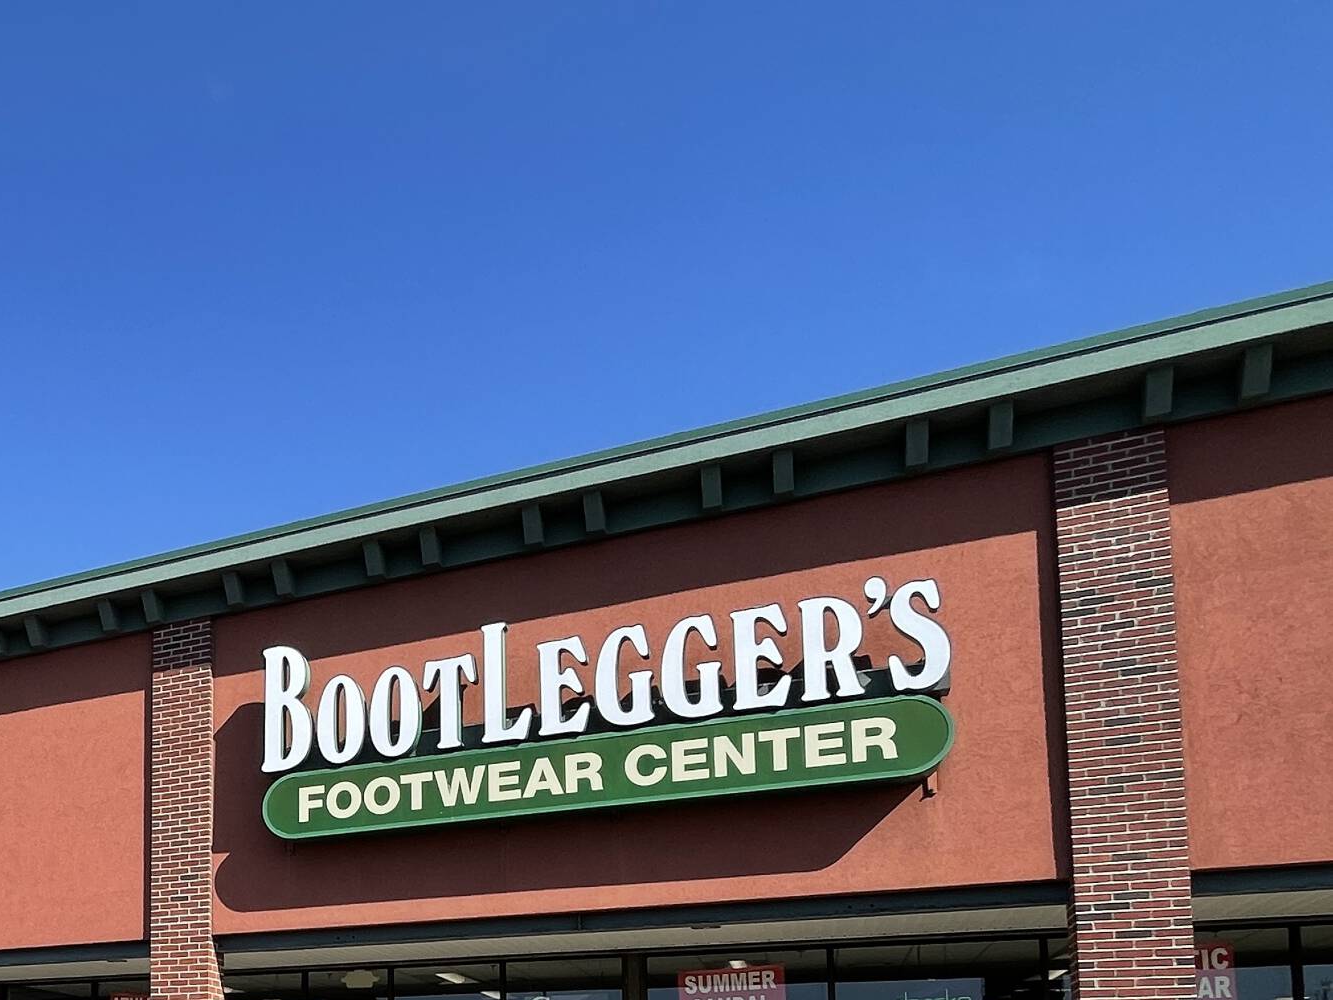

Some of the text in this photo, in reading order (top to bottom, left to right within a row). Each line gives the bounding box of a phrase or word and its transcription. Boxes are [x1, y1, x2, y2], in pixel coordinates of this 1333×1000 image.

[261, 576, 952, 773] BOOTLEGGER'S
[297, 716, 899, 824] FOOTWEAR CENTER
[685, 970, 777, 995] SUMMER
[1198, 976, 1232, 999] AR
